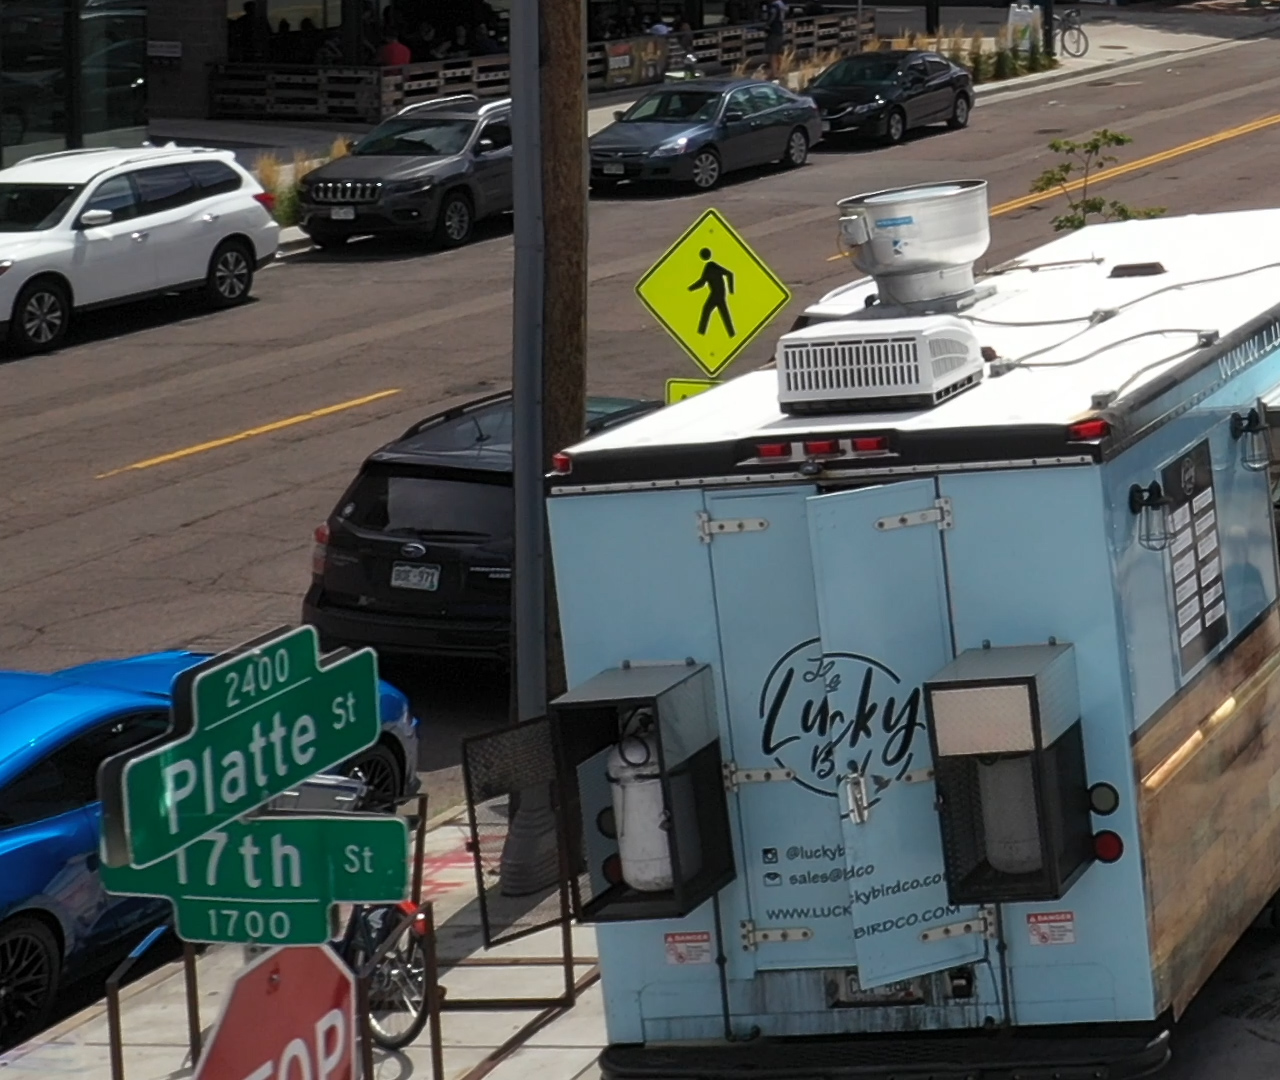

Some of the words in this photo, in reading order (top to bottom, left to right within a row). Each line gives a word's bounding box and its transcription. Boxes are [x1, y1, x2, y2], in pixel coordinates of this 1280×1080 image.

[224, 648, 290, 708] 2400
[165, 711, 317, 835] Platte
[331, 691, 357, 730] St
[175, 832, 302, 888] 17th
[343, 845, 374, 873] St
[208, 909, 291, 939] 1700
